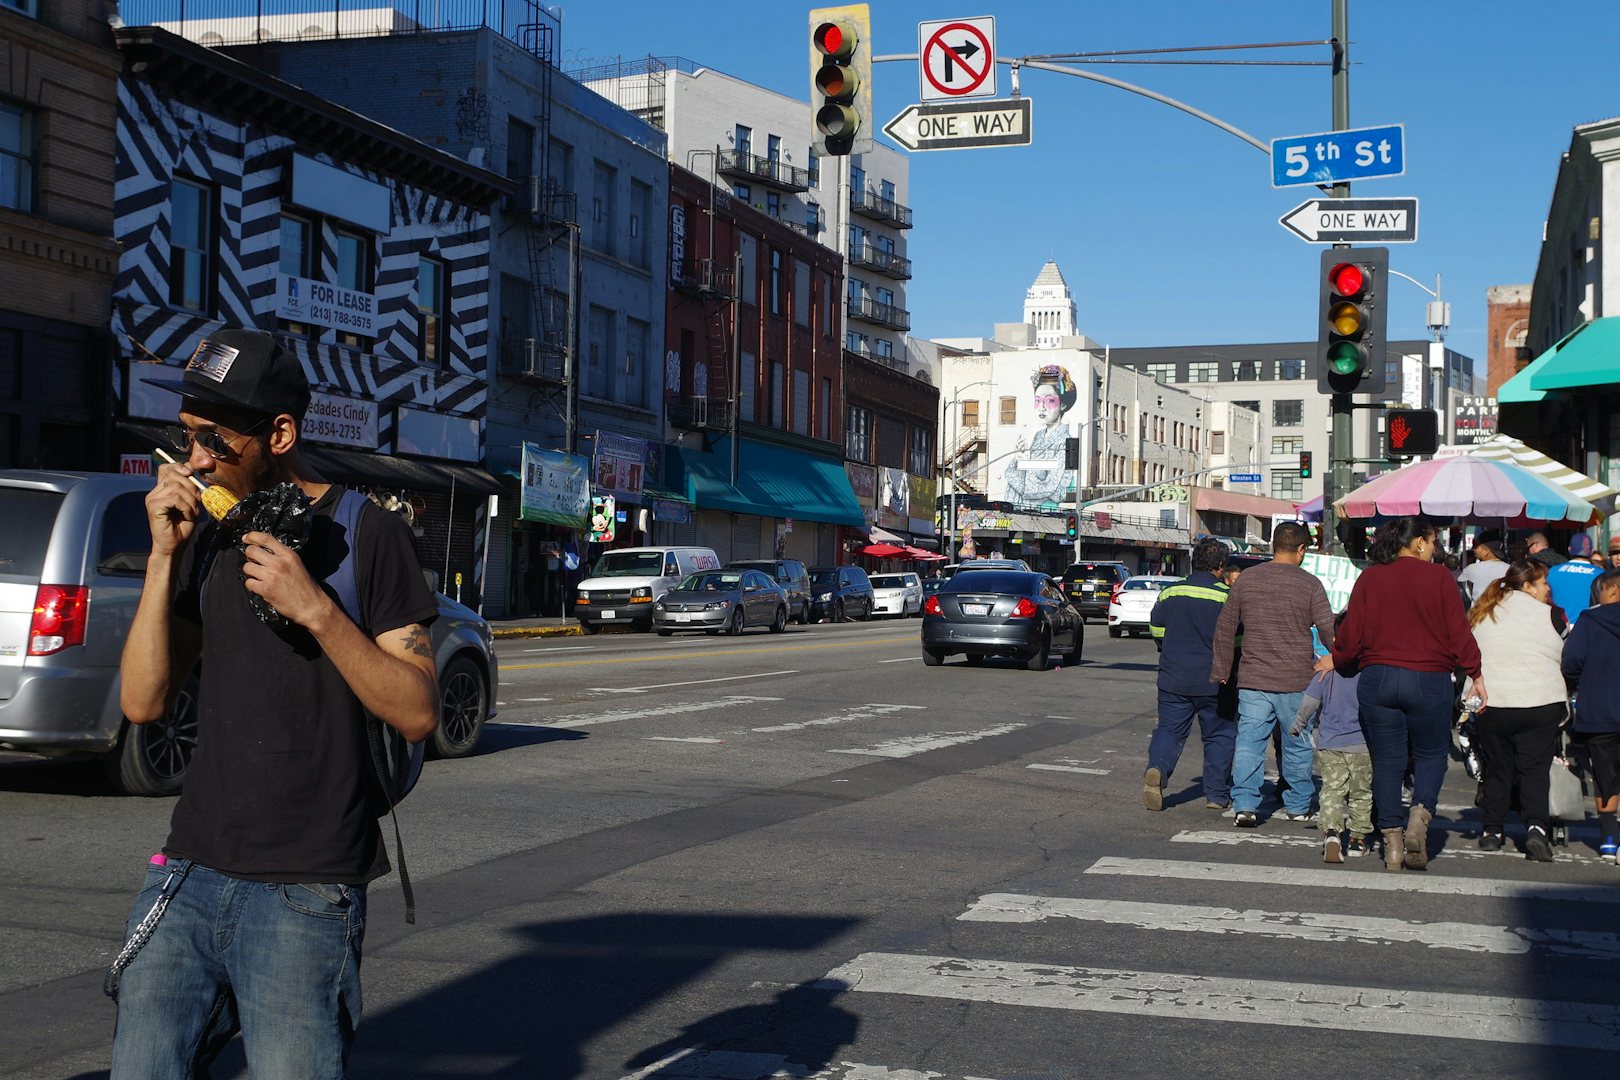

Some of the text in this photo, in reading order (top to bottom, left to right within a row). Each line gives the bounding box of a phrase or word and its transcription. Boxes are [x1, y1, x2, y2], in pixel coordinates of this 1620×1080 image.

[918, 112, 1017, 138] ONE WAY
[1285, 139, 1392, 177] 5th St
[1320, 213, 1401, 228] ONE WAY
[287, 297, 299, 307] FCE
[311, 284, 371, 314] FOR LEASE
[310, 304, 332, 323] (213)
[334, 311, 371, 329] 788-3575
[1463, 397, 1497, 407] PUB
[308, 399, 369, 426] edades Cindy
[122, 459, 149, 475] ATM
[980, 518, 1012, 528] SUBWAY
